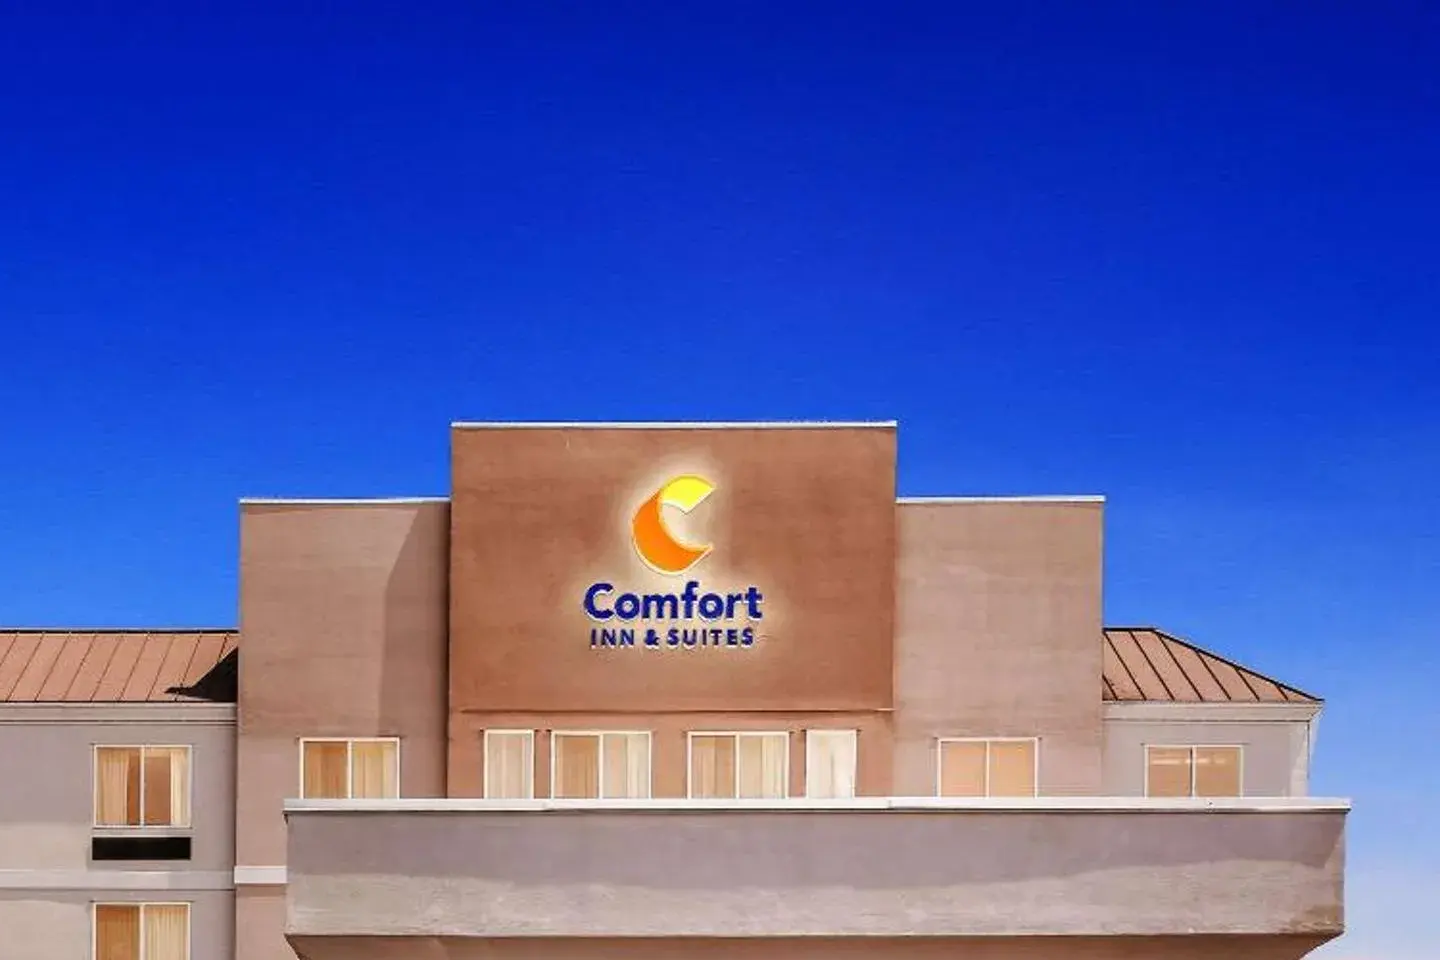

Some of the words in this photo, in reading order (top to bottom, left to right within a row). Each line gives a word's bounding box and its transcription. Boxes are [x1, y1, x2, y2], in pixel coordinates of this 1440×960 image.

[583, 581, 763, 620] Comfort
[590, 628, 635, 647] INN
[644, 628, 660, 647] &
[665, 627, 754, 647] SUITES
